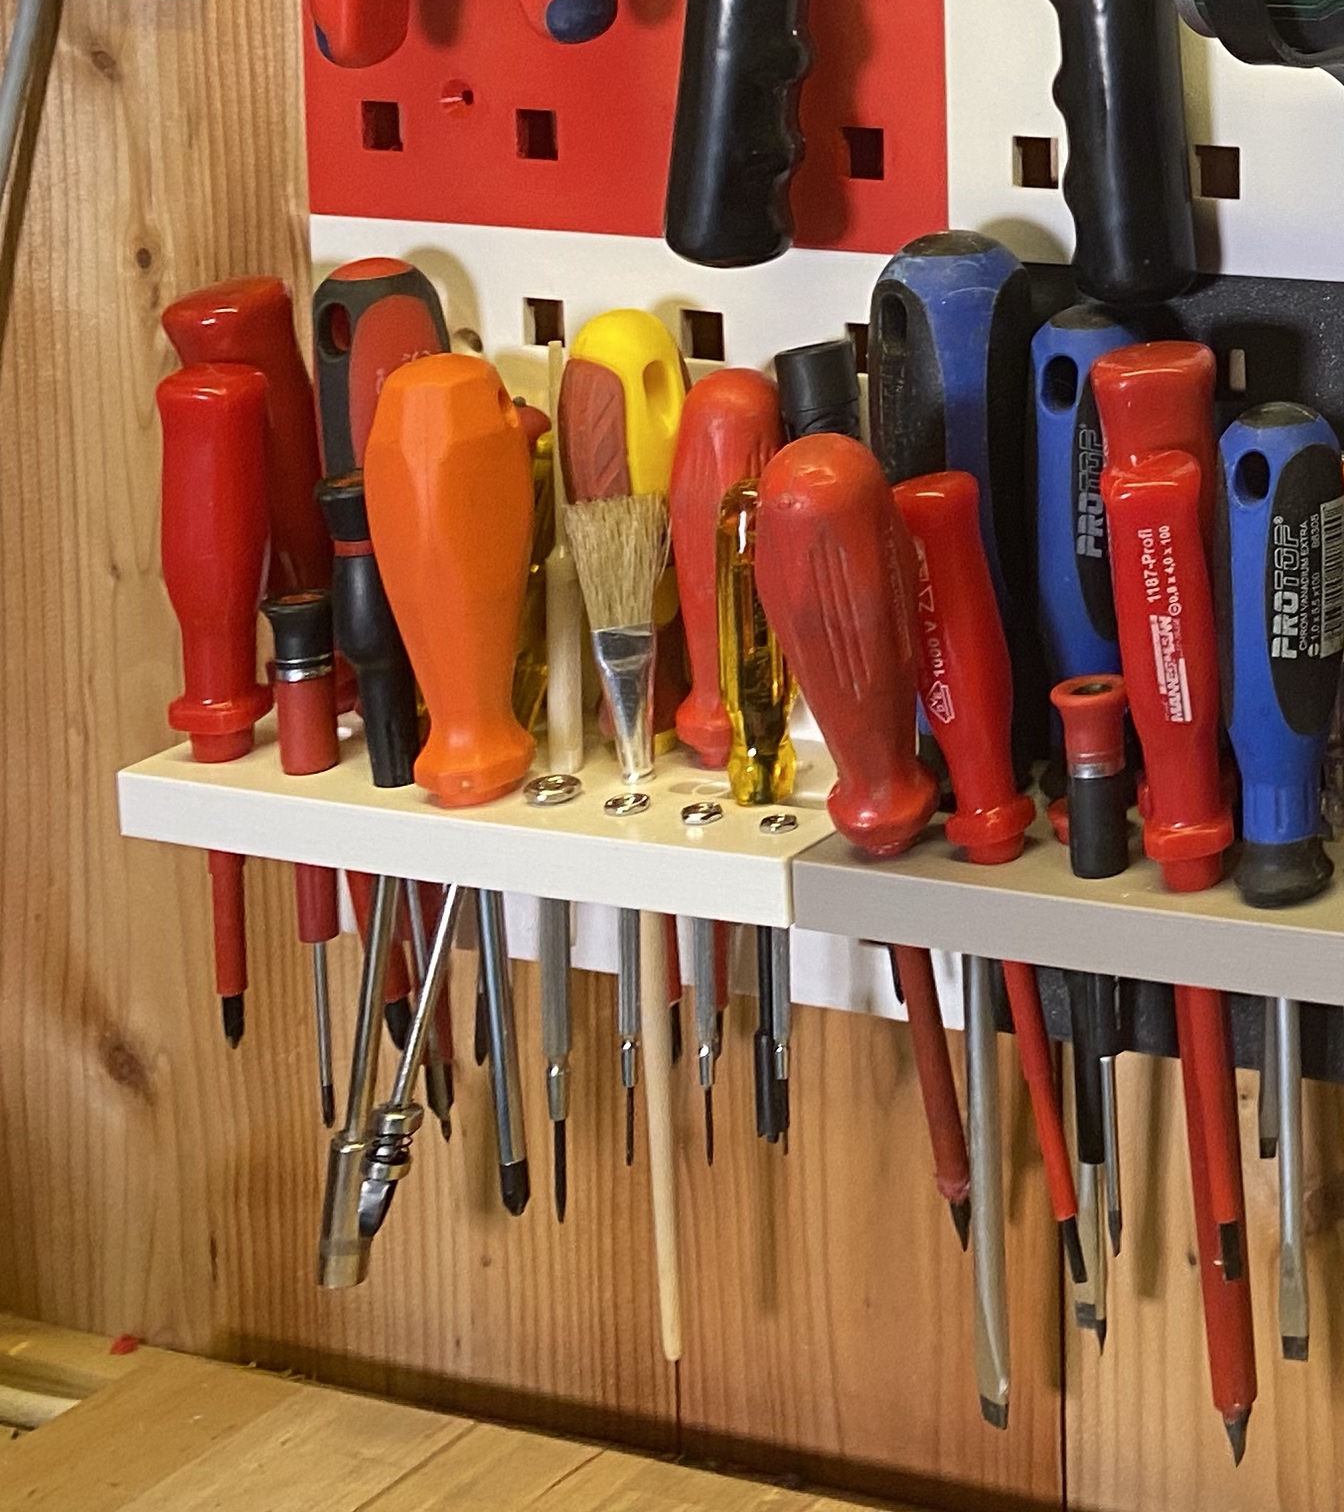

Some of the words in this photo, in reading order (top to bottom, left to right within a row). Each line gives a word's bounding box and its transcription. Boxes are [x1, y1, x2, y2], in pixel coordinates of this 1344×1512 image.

[1158, 525, 1171, 545] 100
[1300, 520, 1309, 556] EXTRA
[1137, 528, 1163, 603] 1187-Profi
[1271, 524, 1299, 659] PROTOP
[928, 638, 946, 677] 1000
